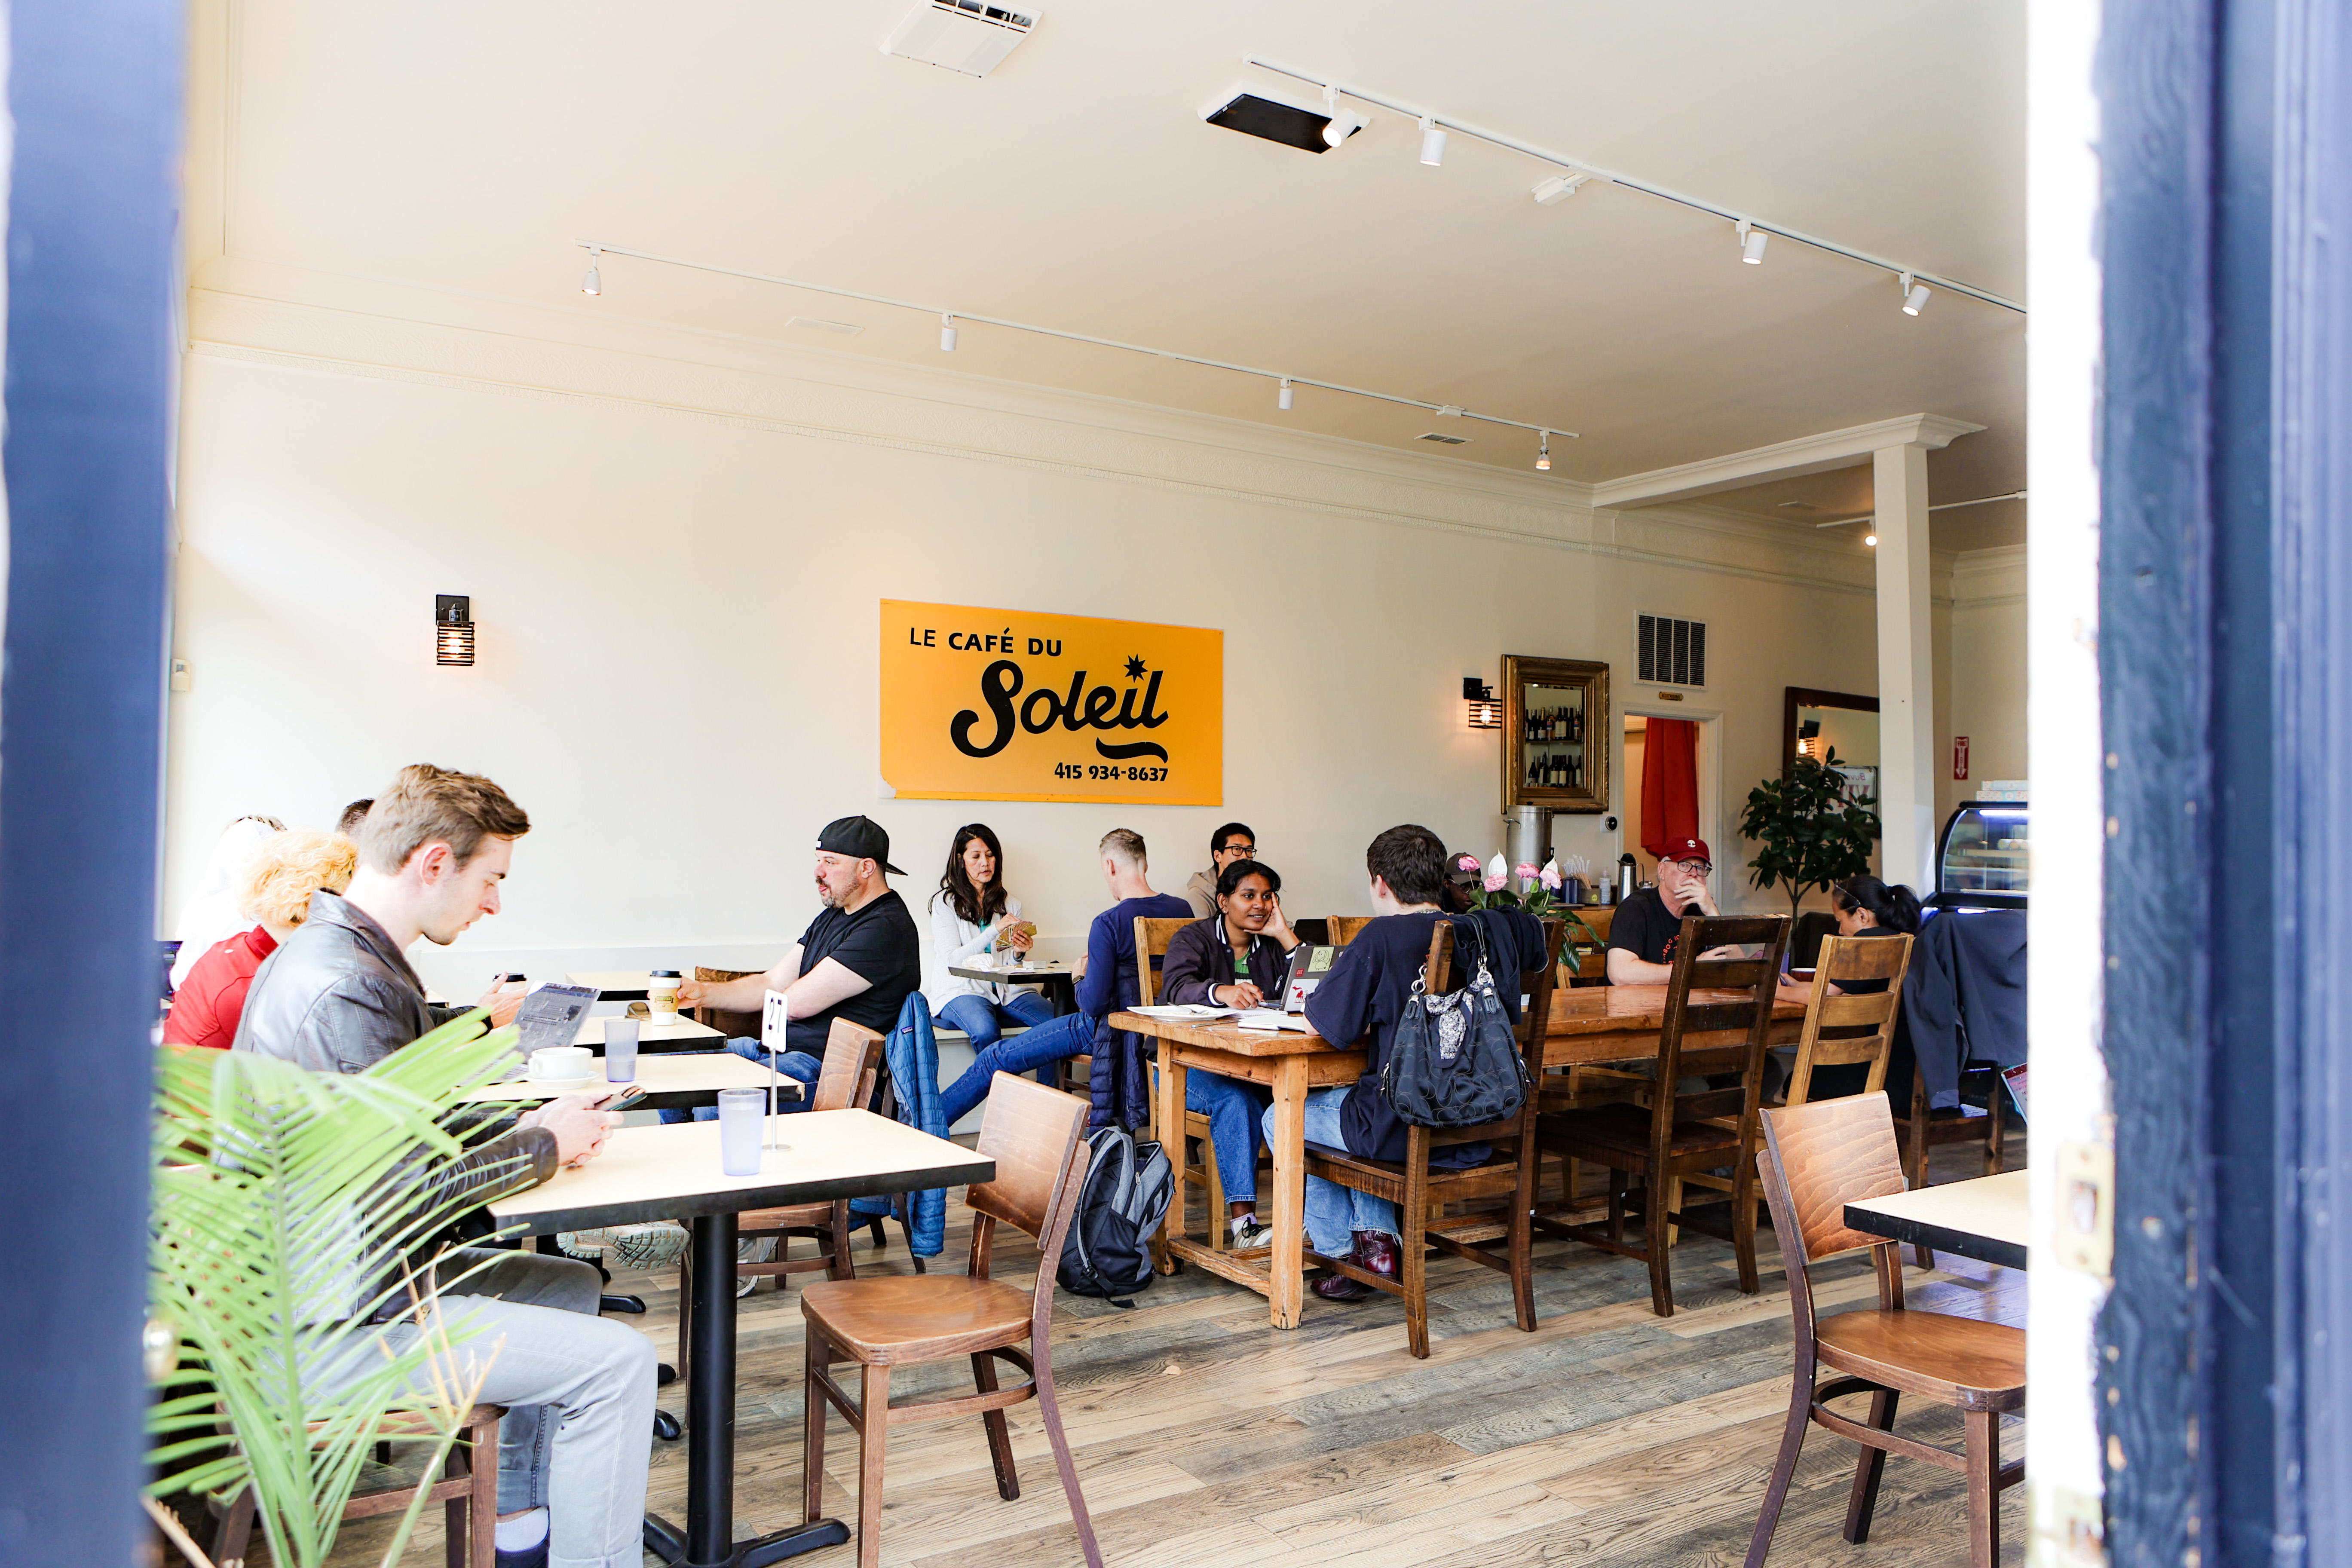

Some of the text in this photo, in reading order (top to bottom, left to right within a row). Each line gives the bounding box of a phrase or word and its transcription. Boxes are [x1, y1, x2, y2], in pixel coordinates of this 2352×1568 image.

[910, 627, 1062, 657] LE CAFÉ DU
[950, 654, 1169, 758] Soleil
[1054, 762, 1168, 781] 415 934-8637
[768, 997, 782, 1033] 27
